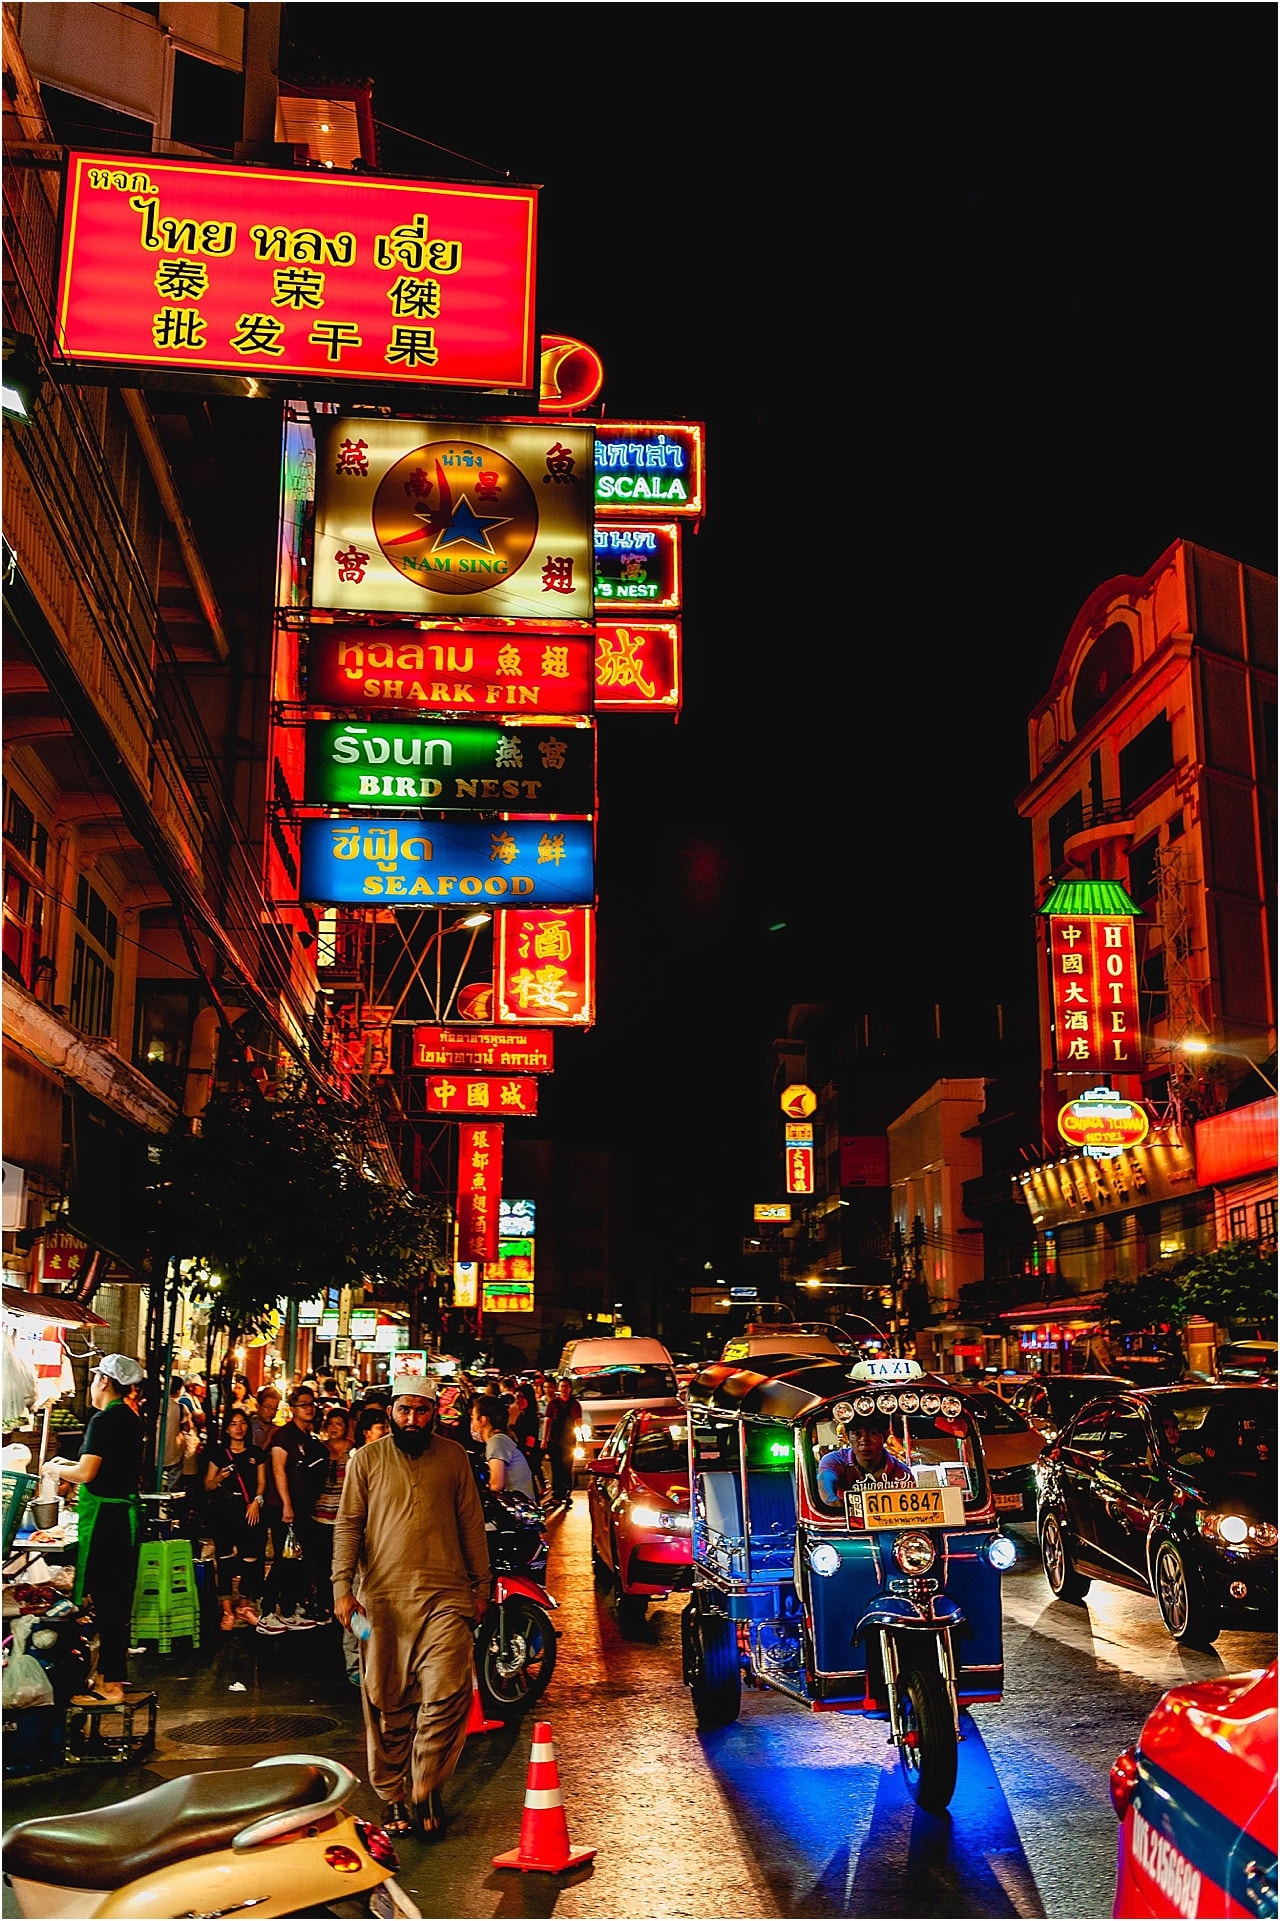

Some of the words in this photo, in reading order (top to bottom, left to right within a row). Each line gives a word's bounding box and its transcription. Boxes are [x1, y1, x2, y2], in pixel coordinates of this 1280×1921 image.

[88, 166, 159, 194] หจก.
[130, 195, 237, 256] ไทย
[252, 222, 356, 268] หลง
[373, 213, 463, 273] เจี่ย
[154, 308, 439, 367] 批发干果
[596, 475, 688, 500] SCALA
[402, 554, 452, 576] NAM
[458, 556, 510, 577] SING
[617, 584, 658, 597] NEST
[338, 640, 474, 680] หูฉลาม
[496, 642, 571, 679] 魚翅
[363, 680, 475, 705] SHARK
[485, 684, 541, 706] FIN
[332, 725, 453, 766] รังนก
[358, 775, 443, 797] BIRD
[455, 778, 542, 799] NEST
[489, 830, 568, 867] 海鮮
[362, 875, 535, 896] SEAFOOD
[1061, 924, 1091, 1062] 中國大酒店
[1104, 926, 1129, 1062] HOTEL
[434, 1079, 526, 1110] 中國城
[867, 1362, 912, 1375] TAXI
[899, 1492, 940, 1512] 6847
